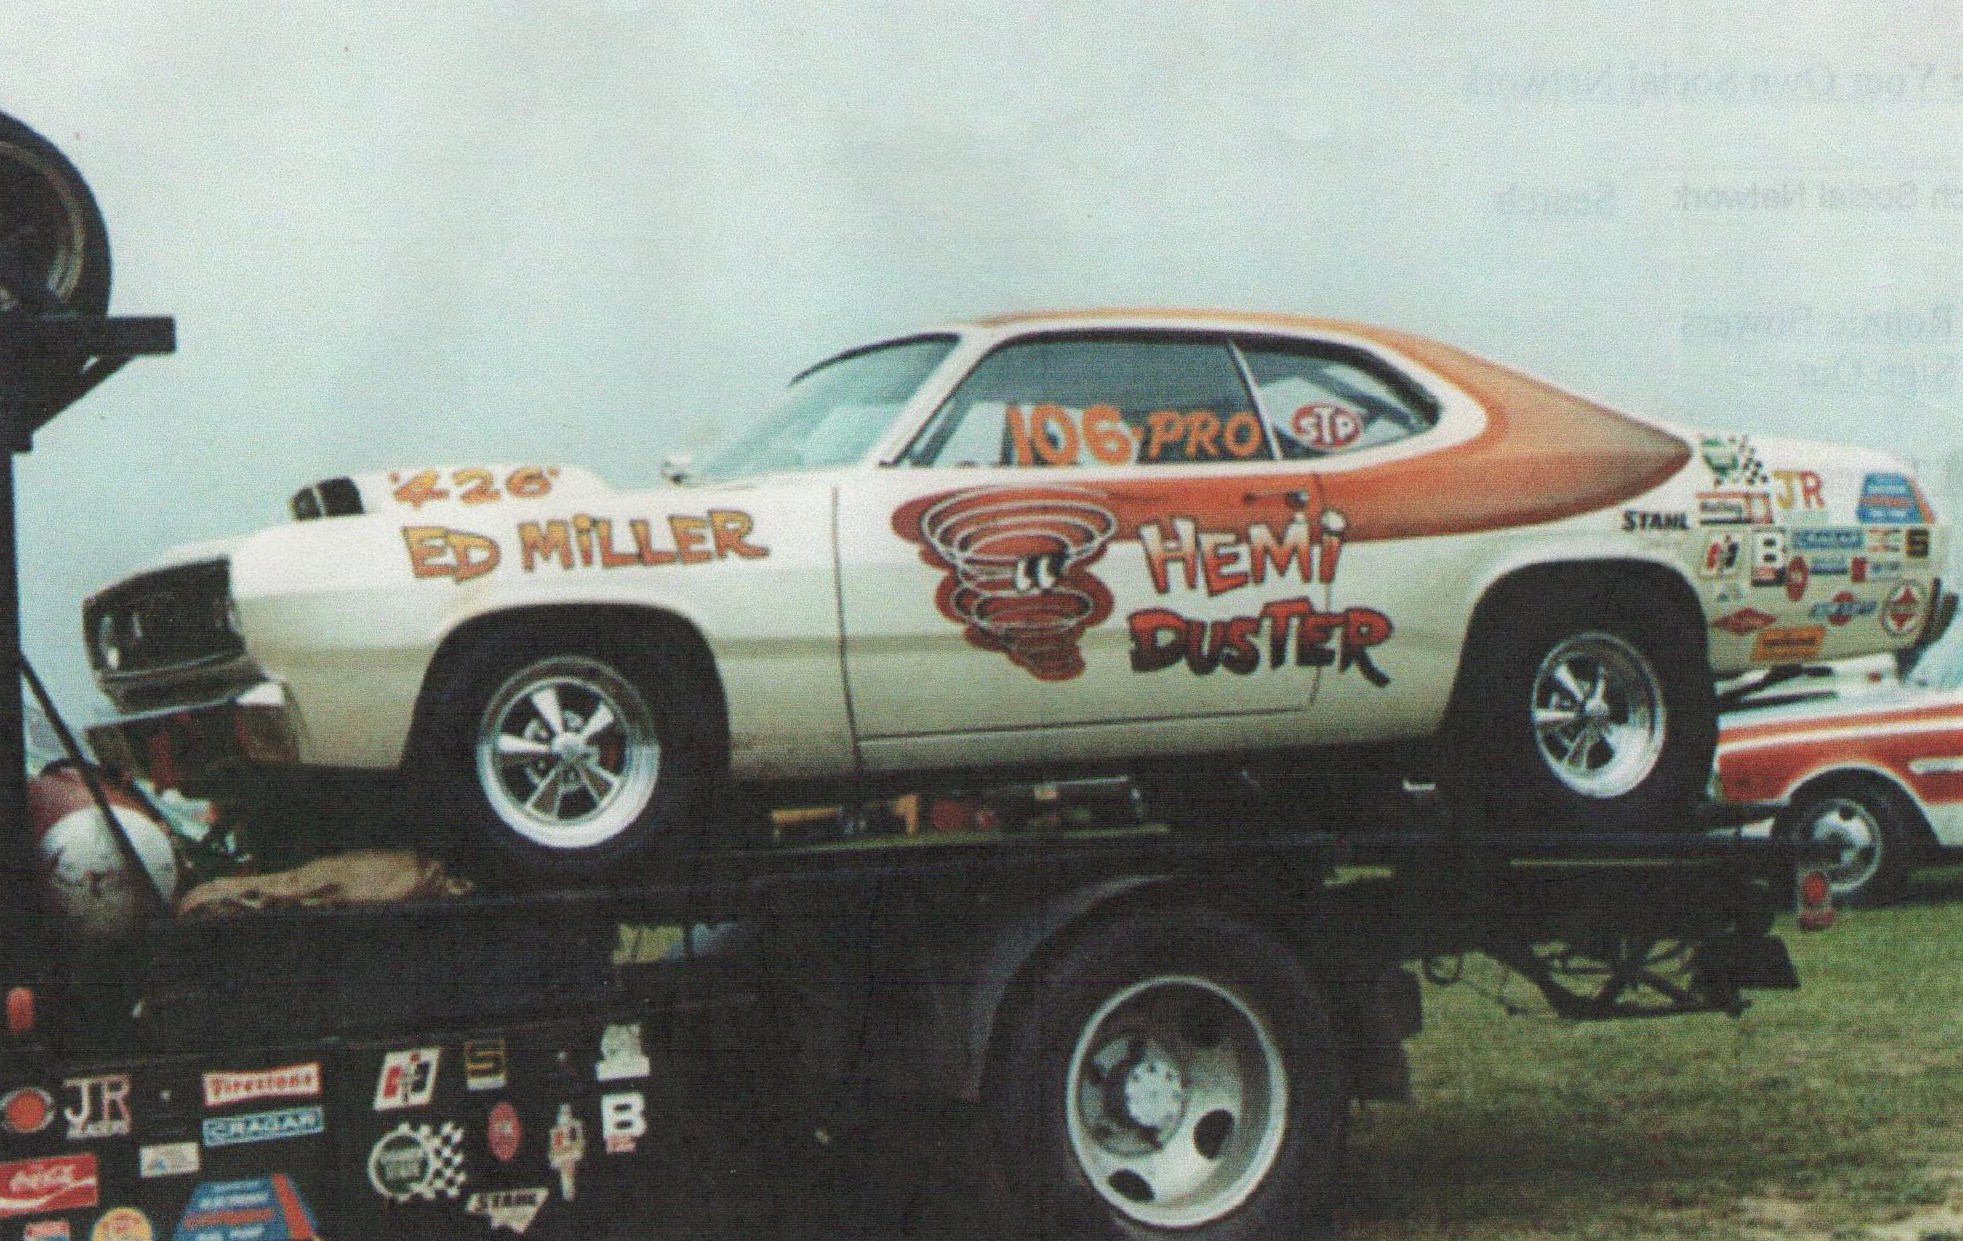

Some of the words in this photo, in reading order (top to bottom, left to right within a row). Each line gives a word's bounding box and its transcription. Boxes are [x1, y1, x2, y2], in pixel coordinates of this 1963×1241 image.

[1004, 402, 1134, 467] 106
[1300, 406, 1356, 445] STP
[1771, 469, 1825, 511] JR
[401, 525, 501, 583] ED
[1127, 595, 1393, 688] DUSTER
[63, 1073, 133, 1131] JR
[210, 1069, 314, 1098] Firestone
[206, 1110, 320, 1142] CRAGAR
[600, 1092, 647, 1139] B
